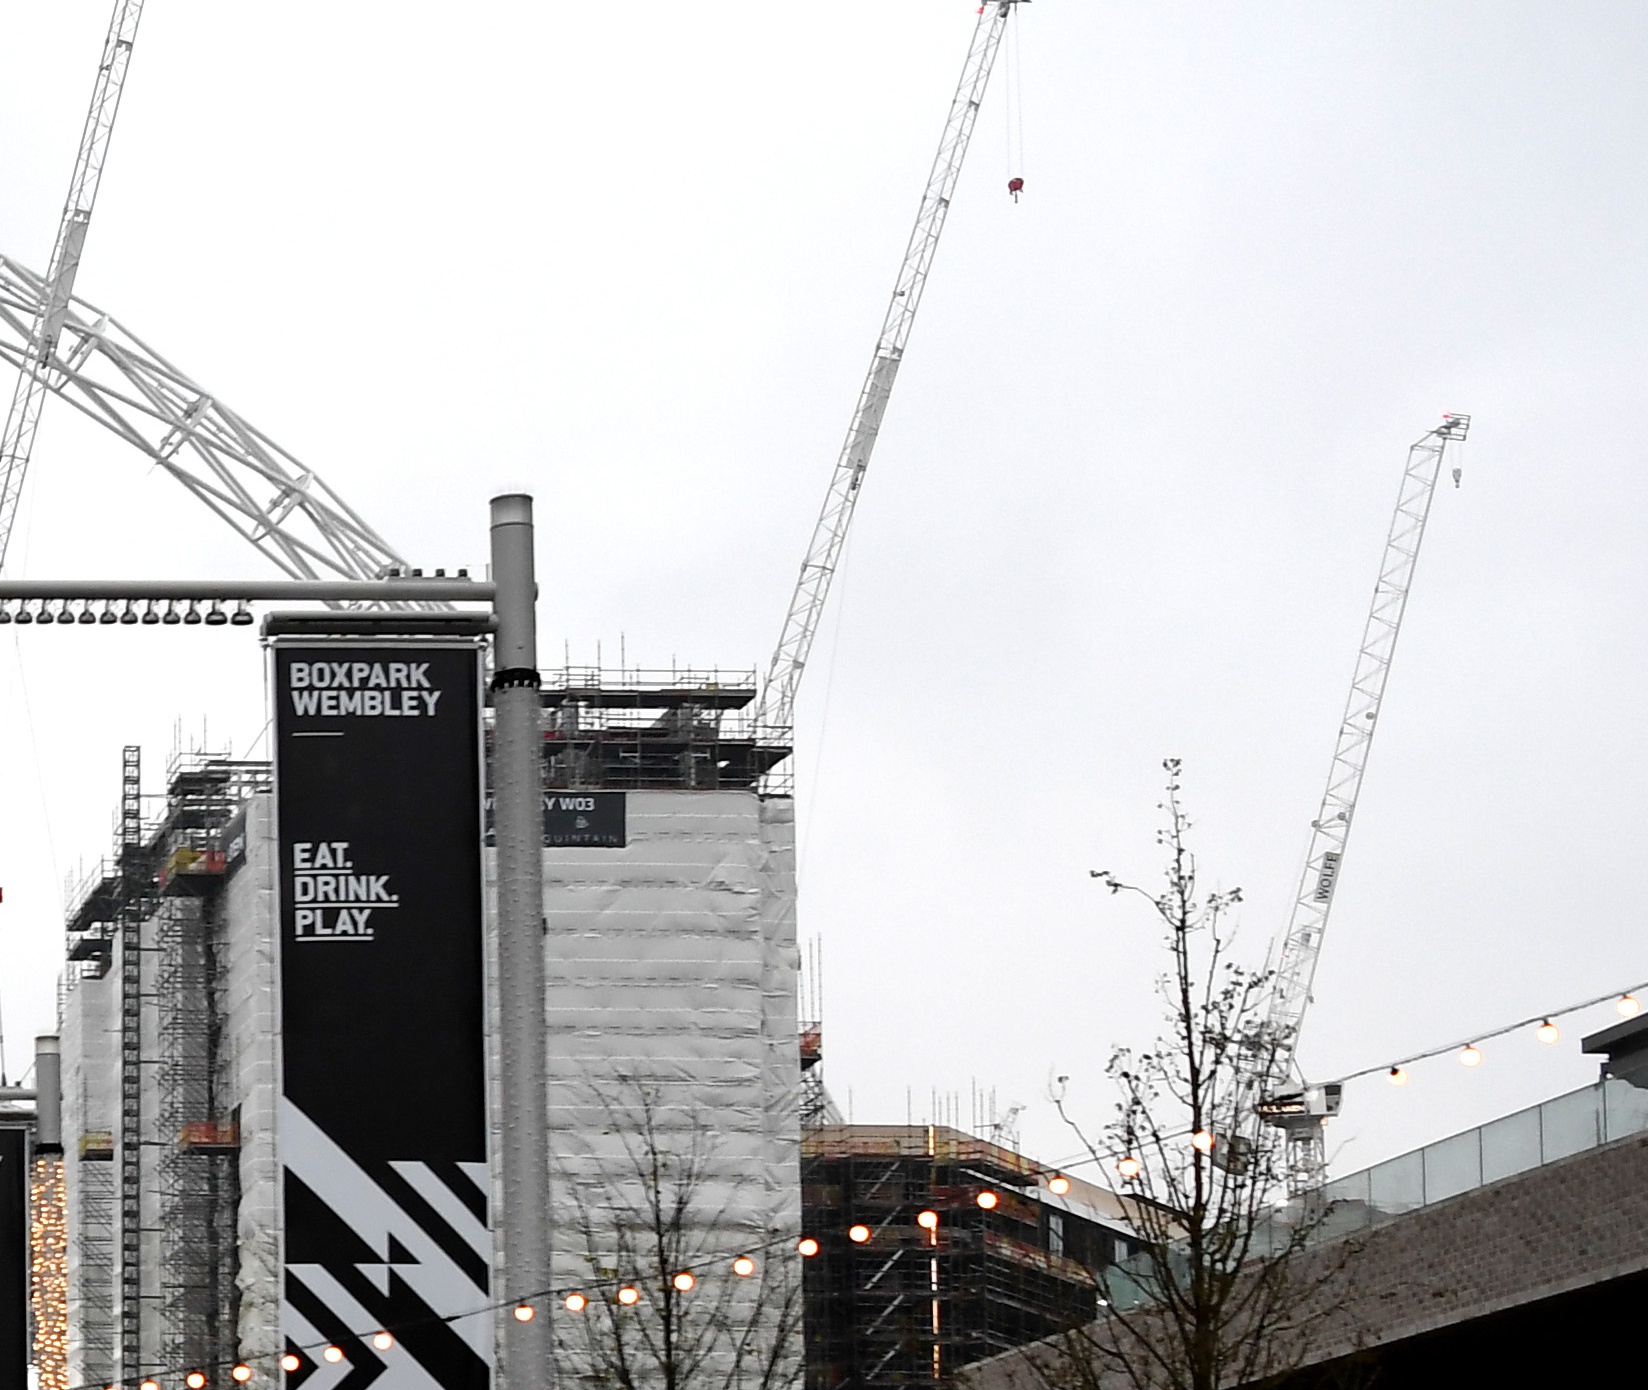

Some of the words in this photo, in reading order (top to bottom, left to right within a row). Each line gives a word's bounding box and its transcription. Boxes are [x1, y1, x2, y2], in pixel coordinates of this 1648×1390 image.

[290, 662, 432, 688] BOXPARK
[291, 690, 442, 717] WEMBLEY
[559, 797, 595, 811] W03
[293, 842, 353, 869] EAT.
[294, 875, 400, 902] DRINK.
[295, 909, 374, 936] PLAY.
